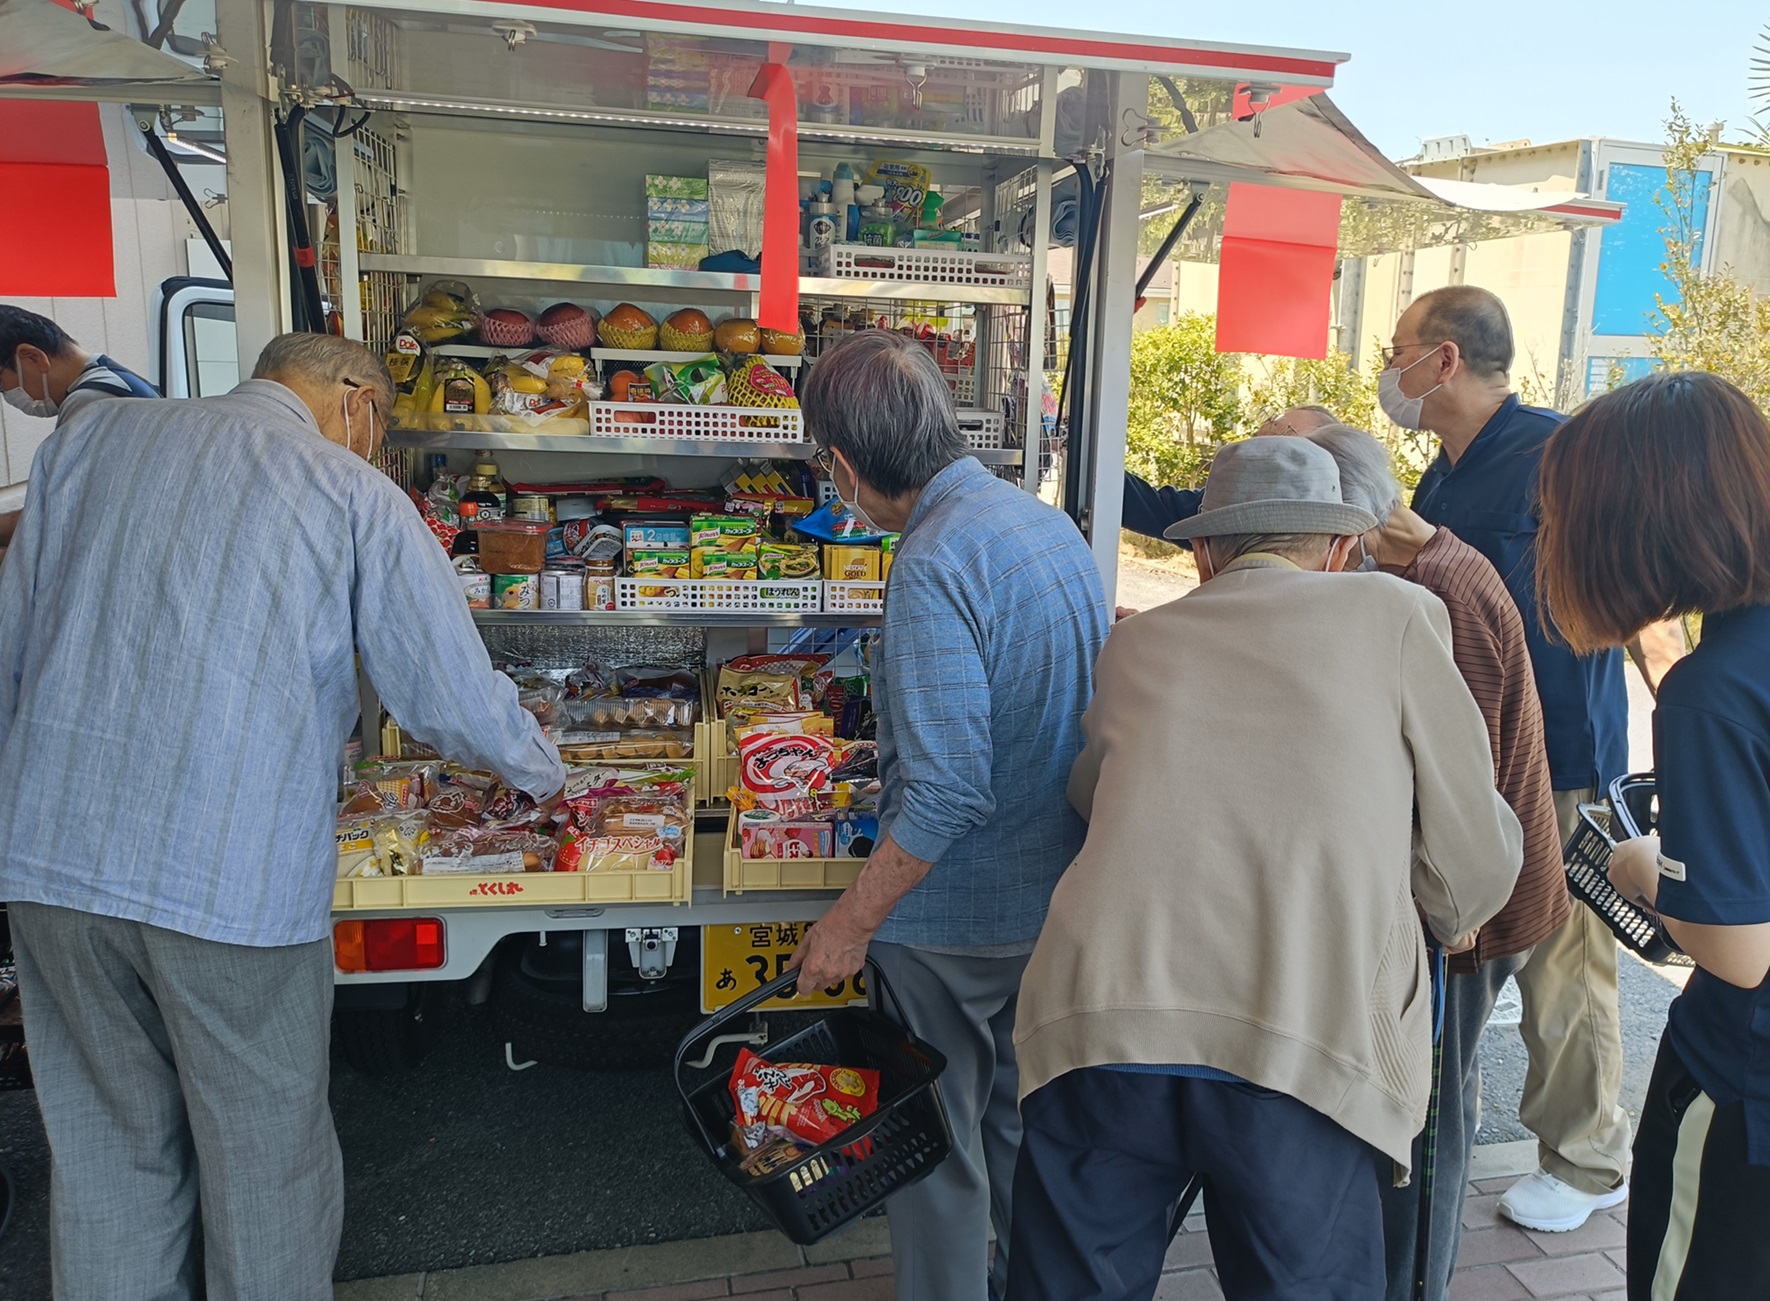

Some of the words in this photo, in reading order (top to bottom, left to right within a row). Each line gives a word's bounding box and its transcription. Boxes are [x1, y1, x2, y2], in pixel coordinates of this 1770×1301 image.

[893, 186, 923, 206] 800
[399, 338, 418, 349] Dole
[698, 531, 719, 540] Knorr
[724, 525, 754, 535] カップスープ
[640, 560, 657, 568] Knorr
[708, 564, 726, 572] Knorr
[755, 747, 818, 769] よっちゃん
[575, 835, 664, 856] イチゴスペシャル
[478, 882, 524, 896] とくし丸
[750, 923, 798, 948] 宮城
[715, 967, 737, 991] あ
